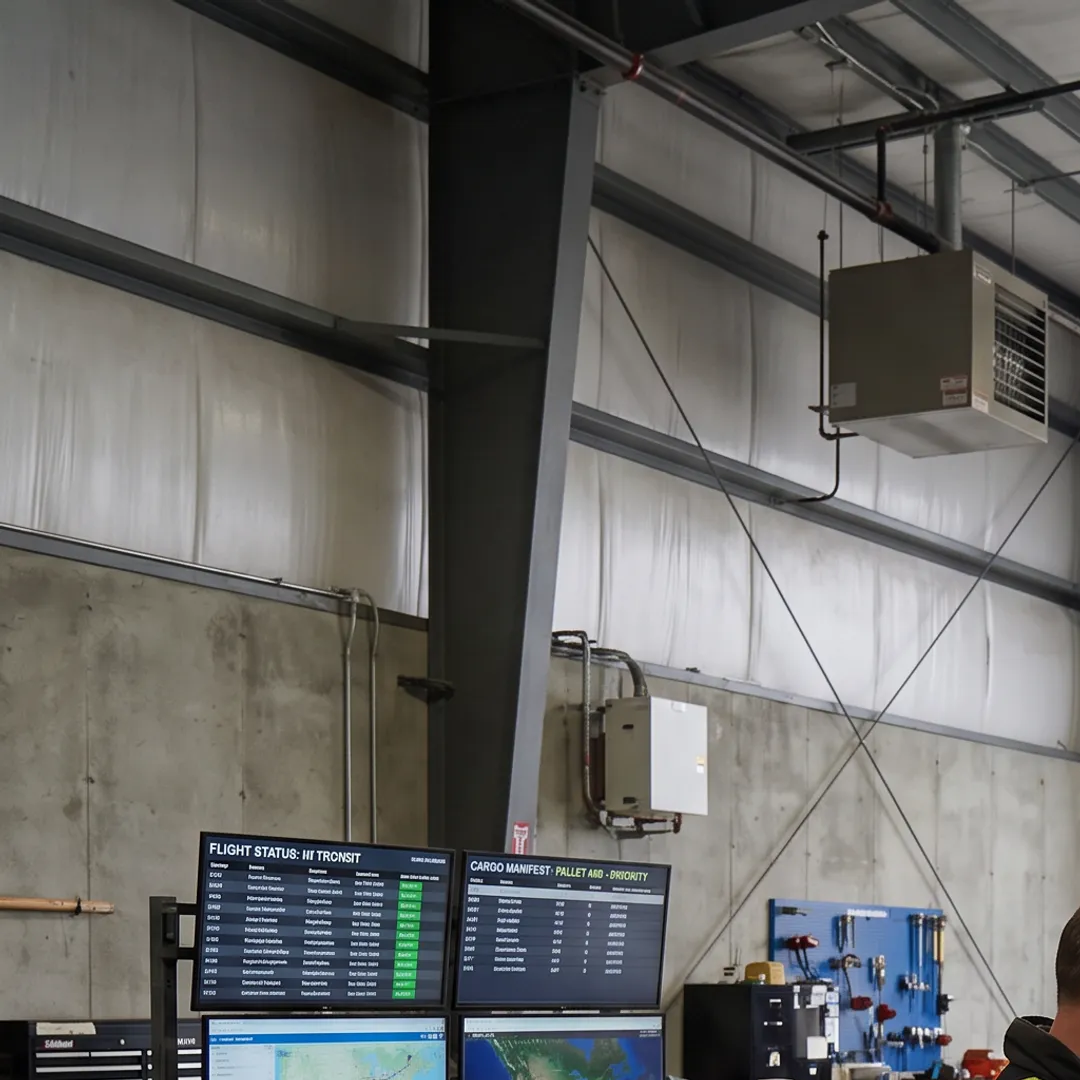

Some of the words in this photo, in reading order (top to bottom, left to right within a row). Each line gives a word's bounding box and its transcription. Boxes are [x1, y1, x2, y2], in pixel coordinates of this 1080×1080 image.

[209, 842, 252, 857] FLIGHT
[254, 845, 300, 860] STATUS:
[470, 860, 504, 873] CARGO
[555, 866, 587, 878] PALLET
